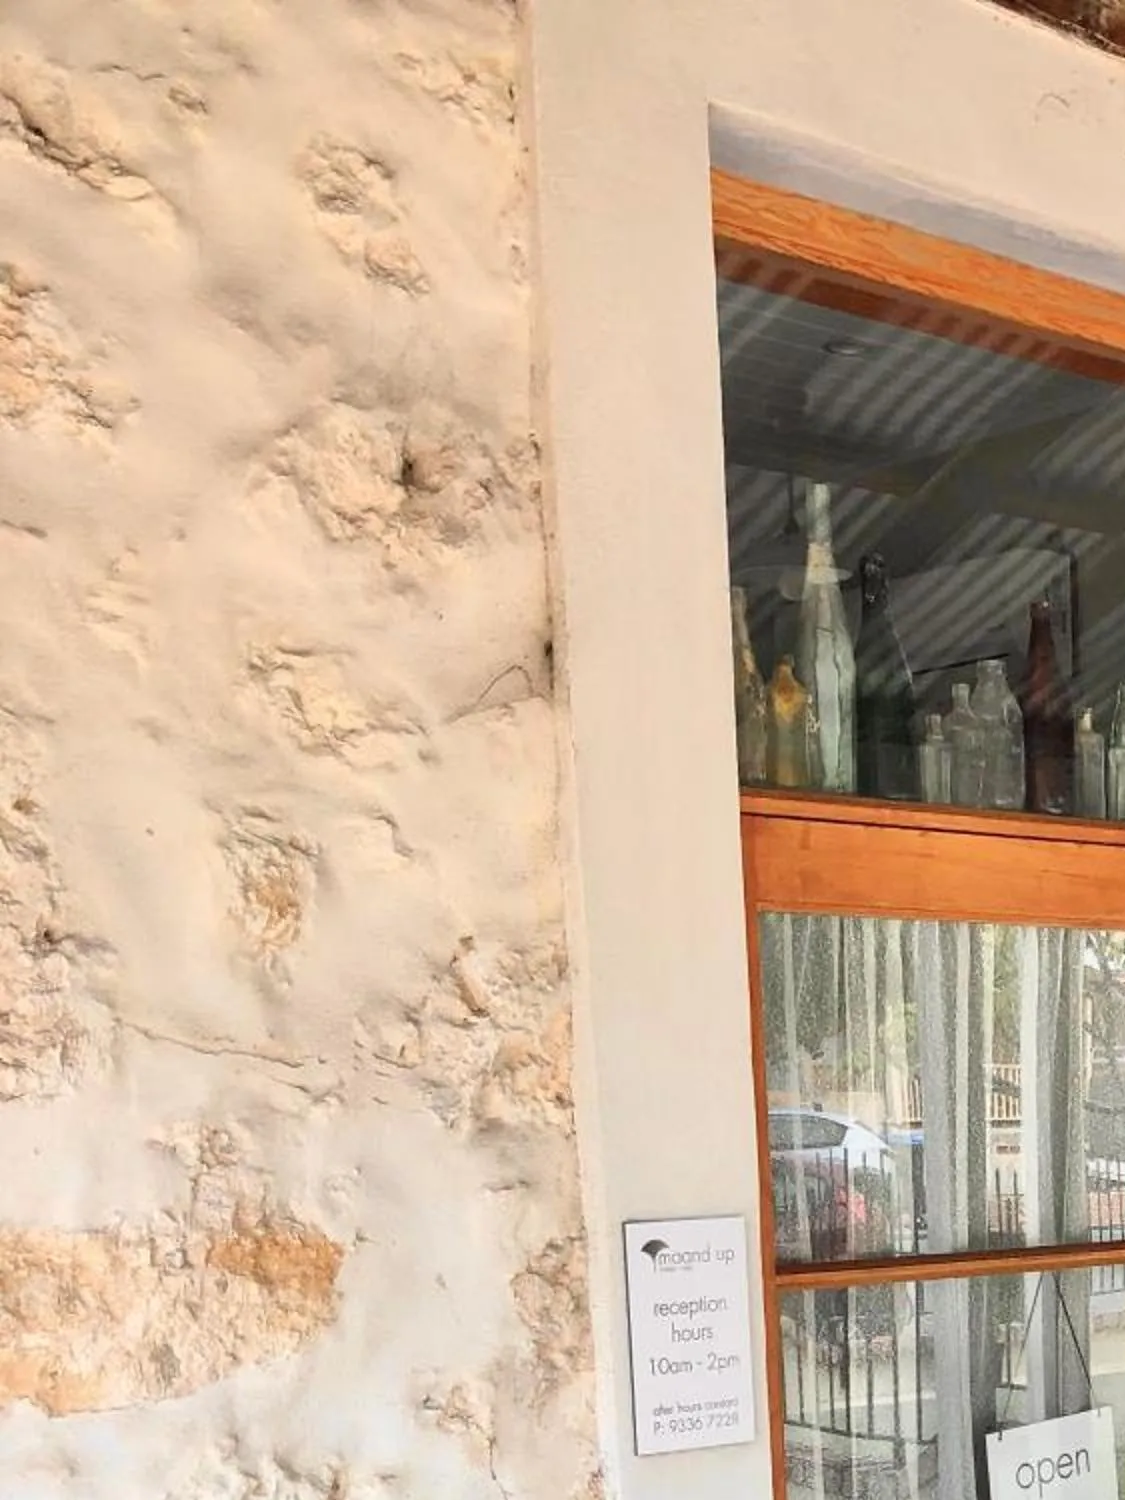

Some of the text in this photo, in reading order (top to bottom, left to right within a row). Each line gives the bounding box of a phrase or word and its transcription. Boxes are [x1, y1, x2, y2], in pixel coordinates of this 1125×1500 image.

[658, 1241, 735, 1265] maand up
[654, 1296, 727, 1320] reception
[671, 1321, 714, 1342] hours
[649, 1357, 693, 1376] 10am
[706, 1352, 740, 1376] 2pm
[1015, 1447, 1091, 1499] open
